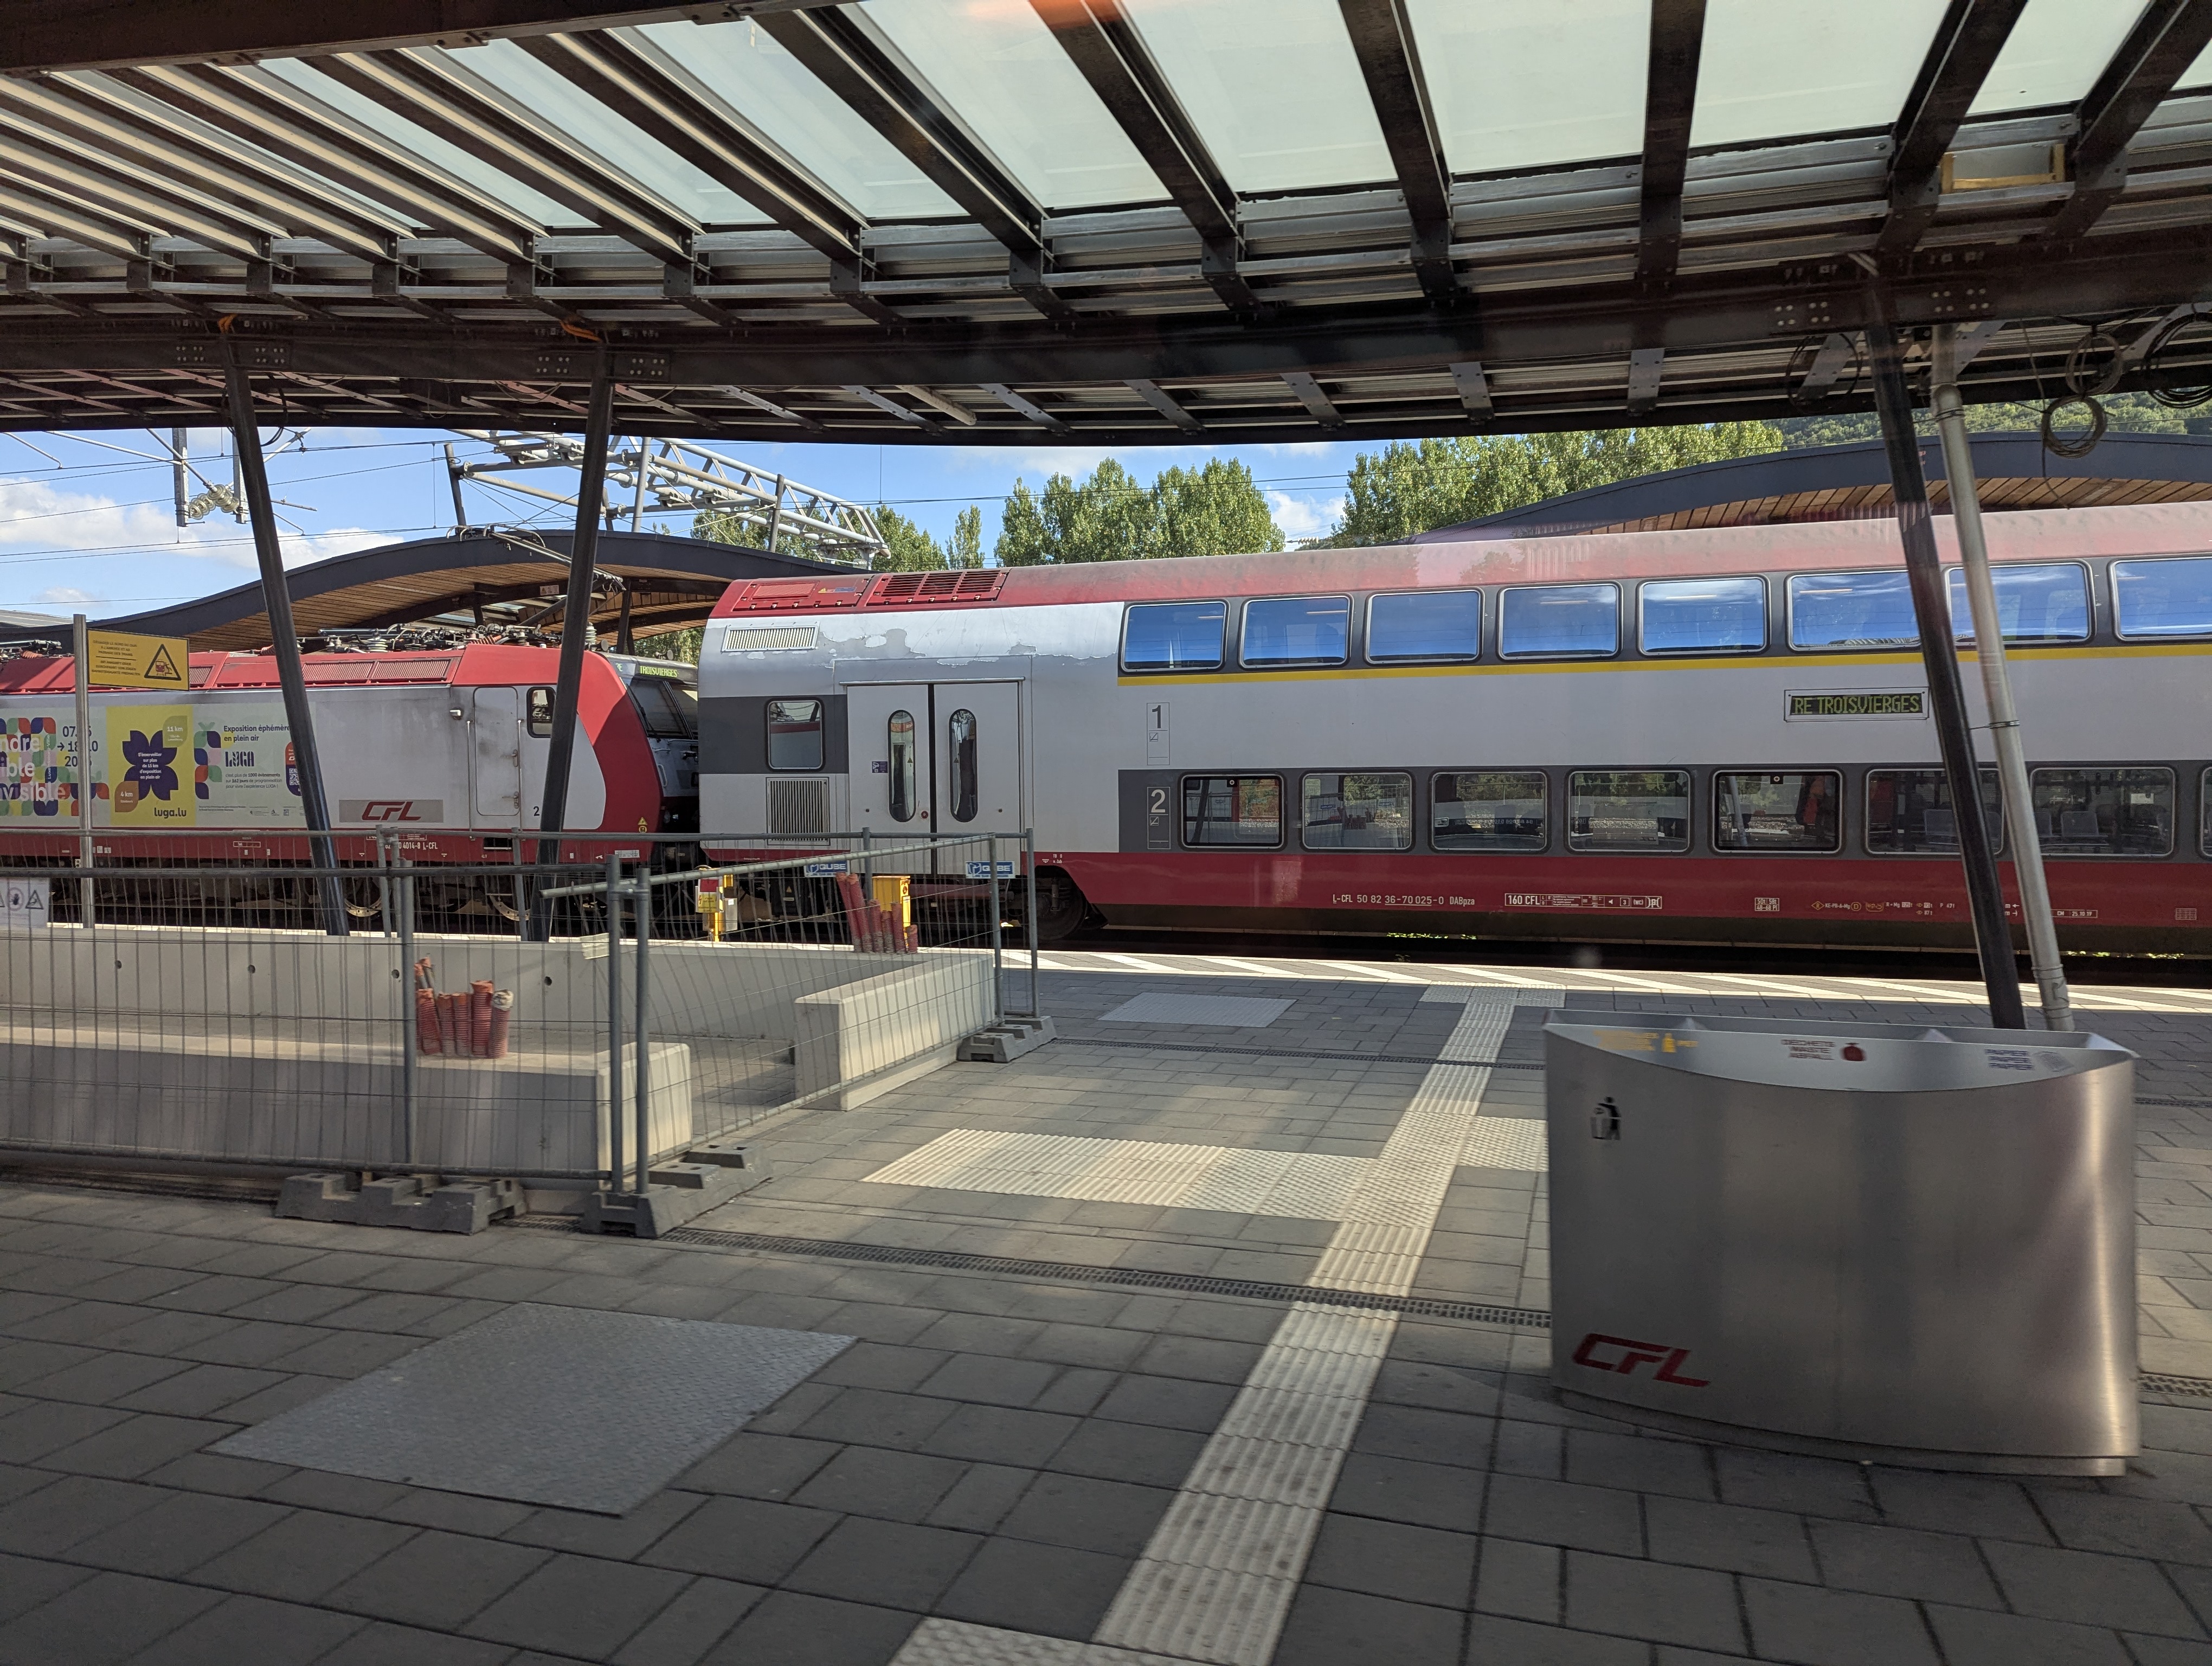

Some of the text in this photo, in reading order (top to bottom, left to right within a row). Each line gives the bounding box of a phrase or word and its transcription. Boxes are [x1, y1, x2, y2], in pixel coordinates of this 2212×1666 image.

[639, 665, 678, 677] TROISVIERGES
[1795, 695, 1919, 714] RE TROISVIERGES
[1152, 705, 1161, 728] 1
[223, 725, 257, 733] Exposition
[225, 751, 255, 767] LUGA
[1151, 790, 1165, 812] 2
[154, 808, 187, 819] luga.lu
[362, 801, 421, 821] CFL
[533, 806, 540, 817] 2
[423, 842, 438, 850] L-CFL
[1333, 894, 1353, 904] L-CFL
[1371, 895, 1382, 904] 82
[1449, 896, 1475, 907] DABpza
[1508, 895, 1523, 905] 160
[1525, 895, 1540, 905] CFL
[1572, 1334, 1711, 1387] CFL
